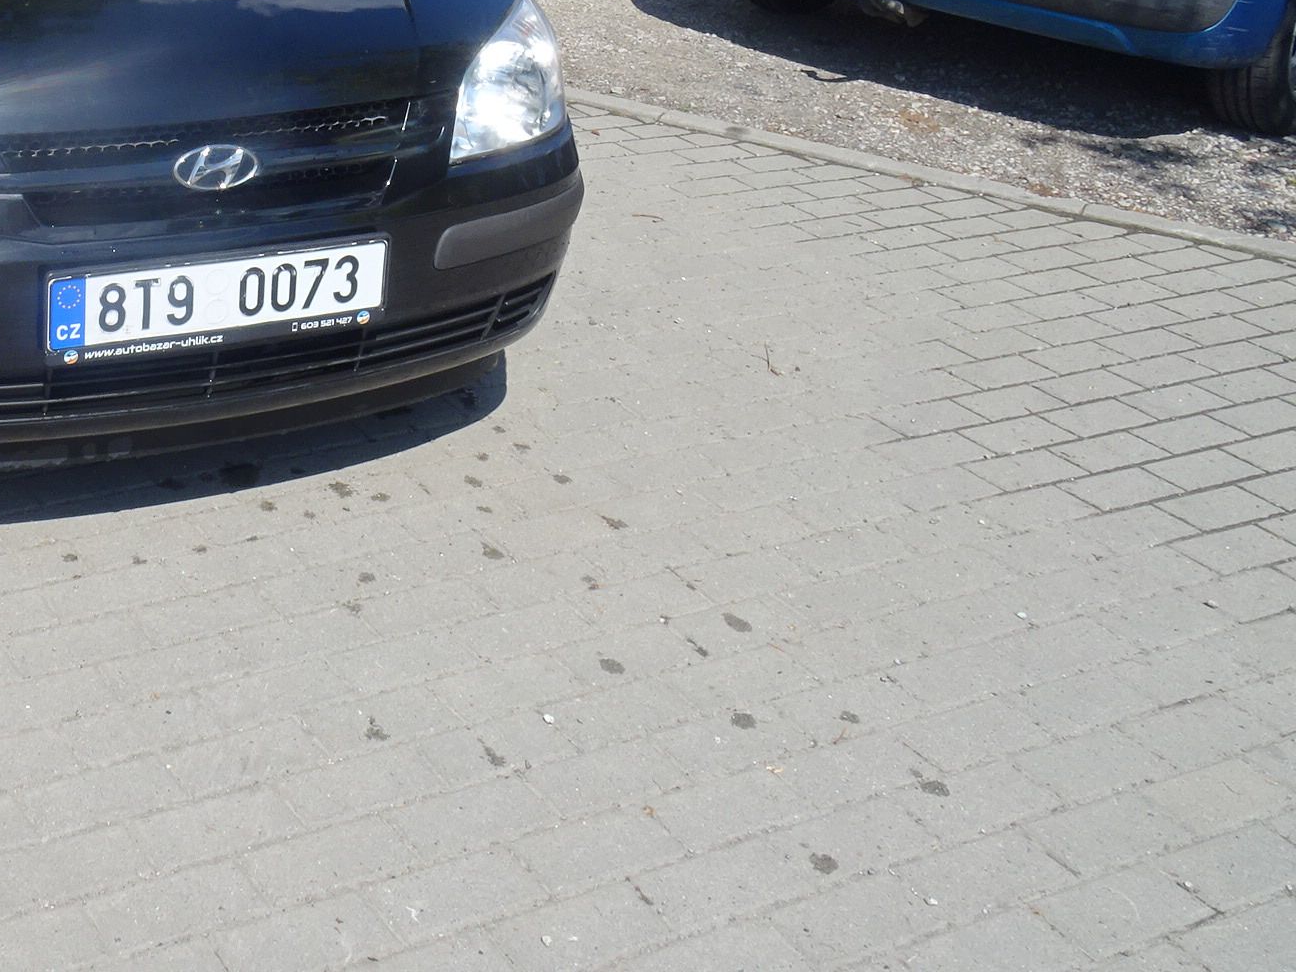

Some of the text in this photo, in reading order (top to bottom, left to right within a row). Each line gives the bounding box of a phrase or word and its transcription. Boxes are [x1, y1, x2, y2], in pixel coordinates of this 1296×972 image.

[97, 254, 360, 333] 8T9 0073
[56, 322, 81, 341] CZ
[300, 316, 353, 330] 603 521 427
[84, 334, 224, 360] www.autobazar-uhlik.cz
